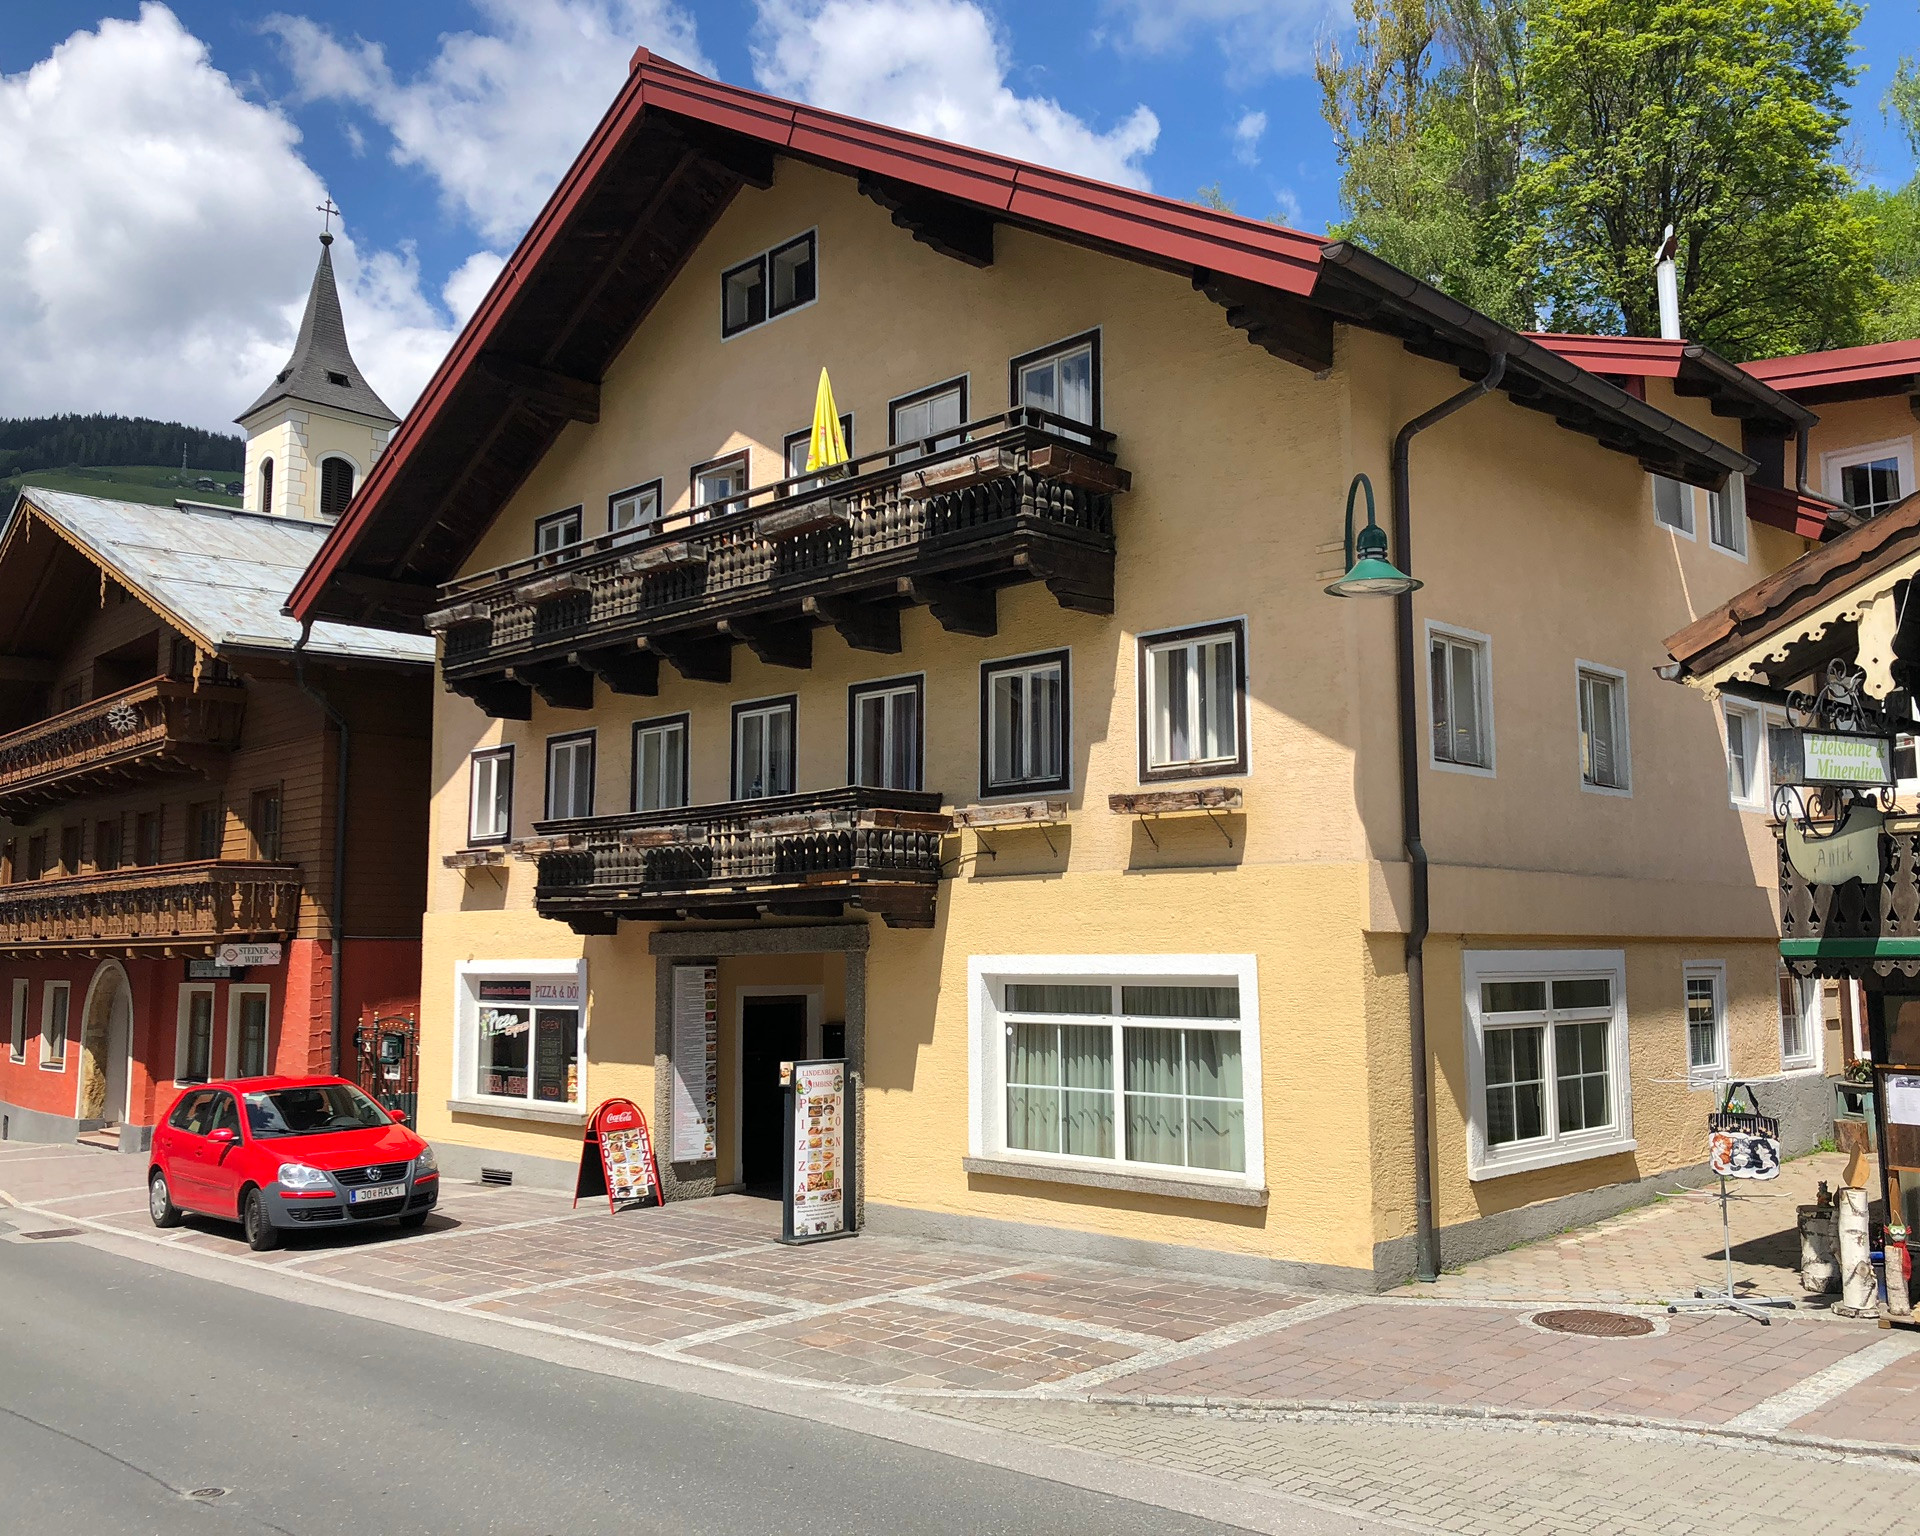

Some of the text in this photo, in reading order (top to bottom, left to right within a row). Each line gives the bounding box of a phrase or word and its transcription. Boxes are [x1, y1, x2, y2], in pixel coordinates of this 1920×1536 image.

[1809, 734, 1885, 758] Edelsteine &
[1816, 758, 1882, 780] Mineralien
[238, 946, 269, 955] STEINER
[244, 955, 264, 964] WIRT
[534, 985, 557, 998] PIZZA
[559, 986, 565, 998] &
[802, 1068, 840, 1077] LINDENBLICK
[812, 1080, 833, 1088] IMBISS
[797, 1098, 807, 1192] PIZZA
[378, 1186, 394, 1197] HAK
